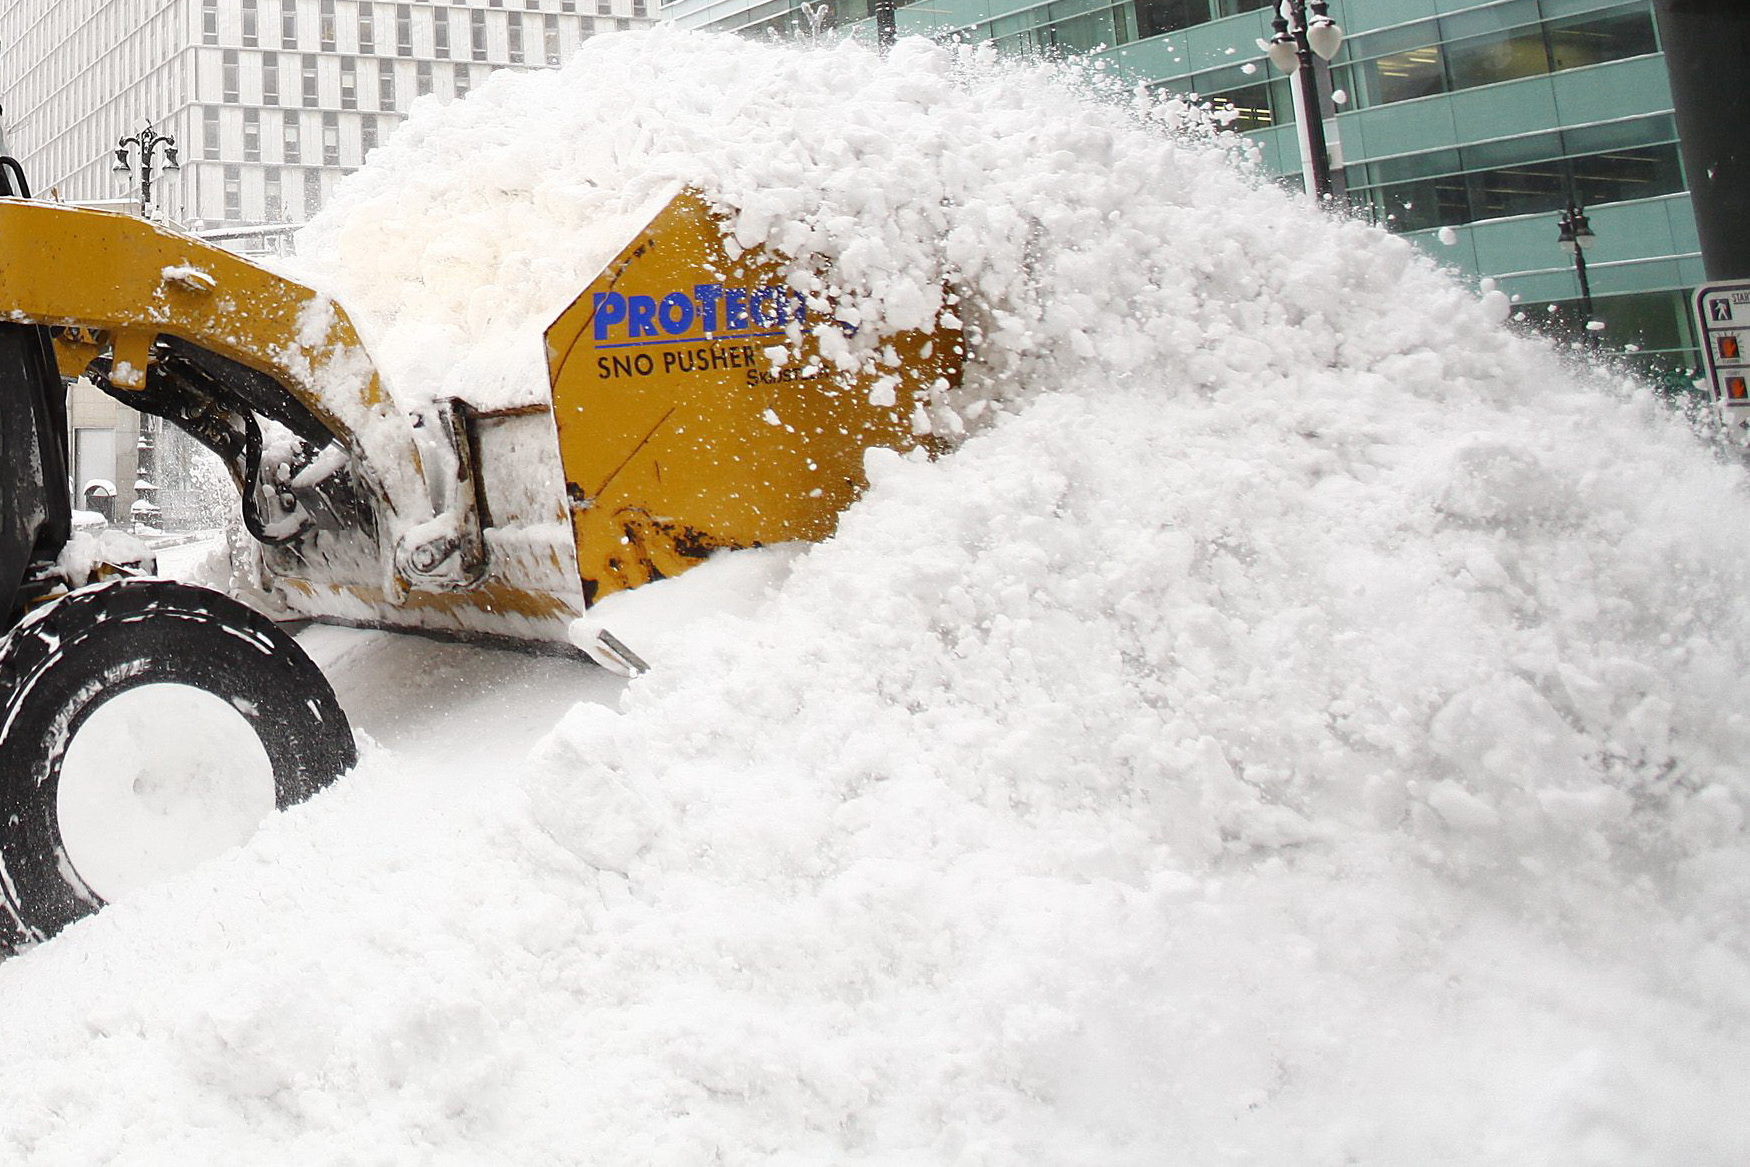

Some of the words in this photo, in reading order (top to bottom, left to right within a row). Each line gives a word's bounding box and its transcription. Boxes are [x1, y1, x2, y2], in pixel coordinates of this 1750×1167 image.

[1732, 292, 1750, 303] STAR
[598, 353, 654, 380] SNO
[664, 345, 756, 373] PUSHER
